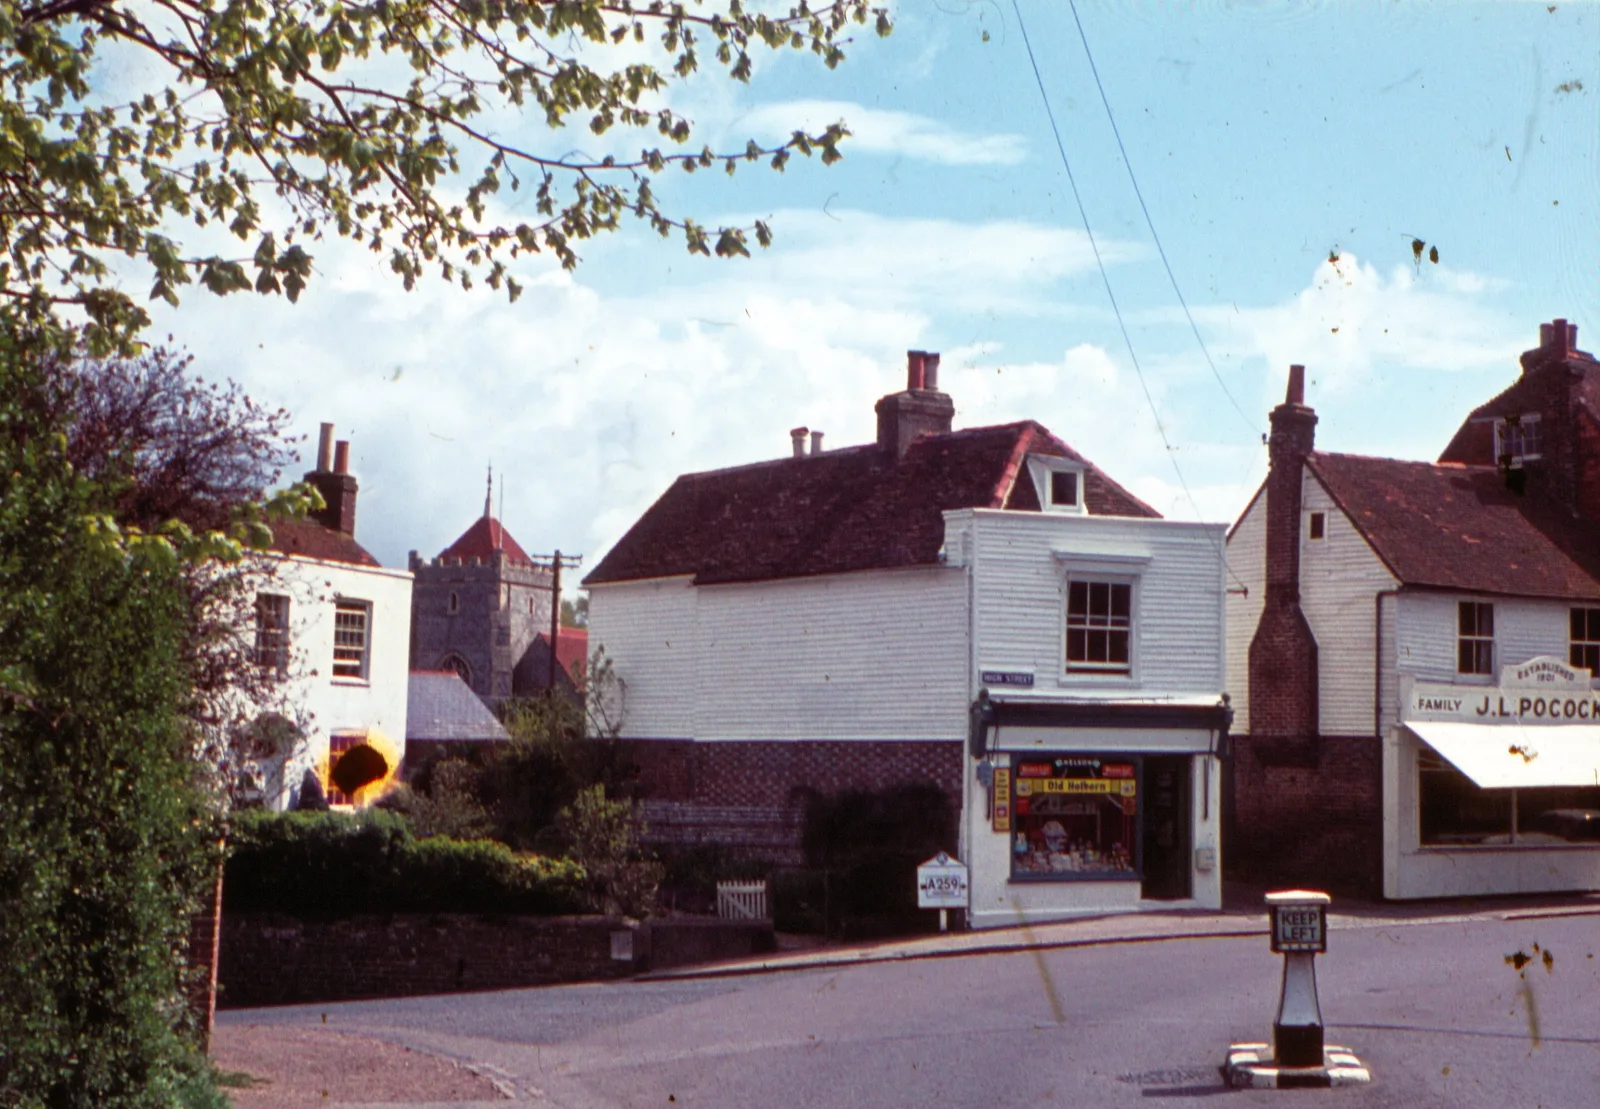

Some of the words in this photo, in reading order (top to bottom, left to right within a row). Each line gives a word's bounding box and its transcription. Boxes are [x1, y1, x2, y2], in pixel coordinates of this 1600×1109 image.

[1517, 661, 1575, 681] ESTABLISHED
[1418, 698, 1462, 711] FAMILY
[1048, 780, 1064, 790] Old
[1068, 780, 1106, 791] Holborn
[1281, 910, 1318, 925] KEEP
[1282, 926, 1317, 940] LEFT
